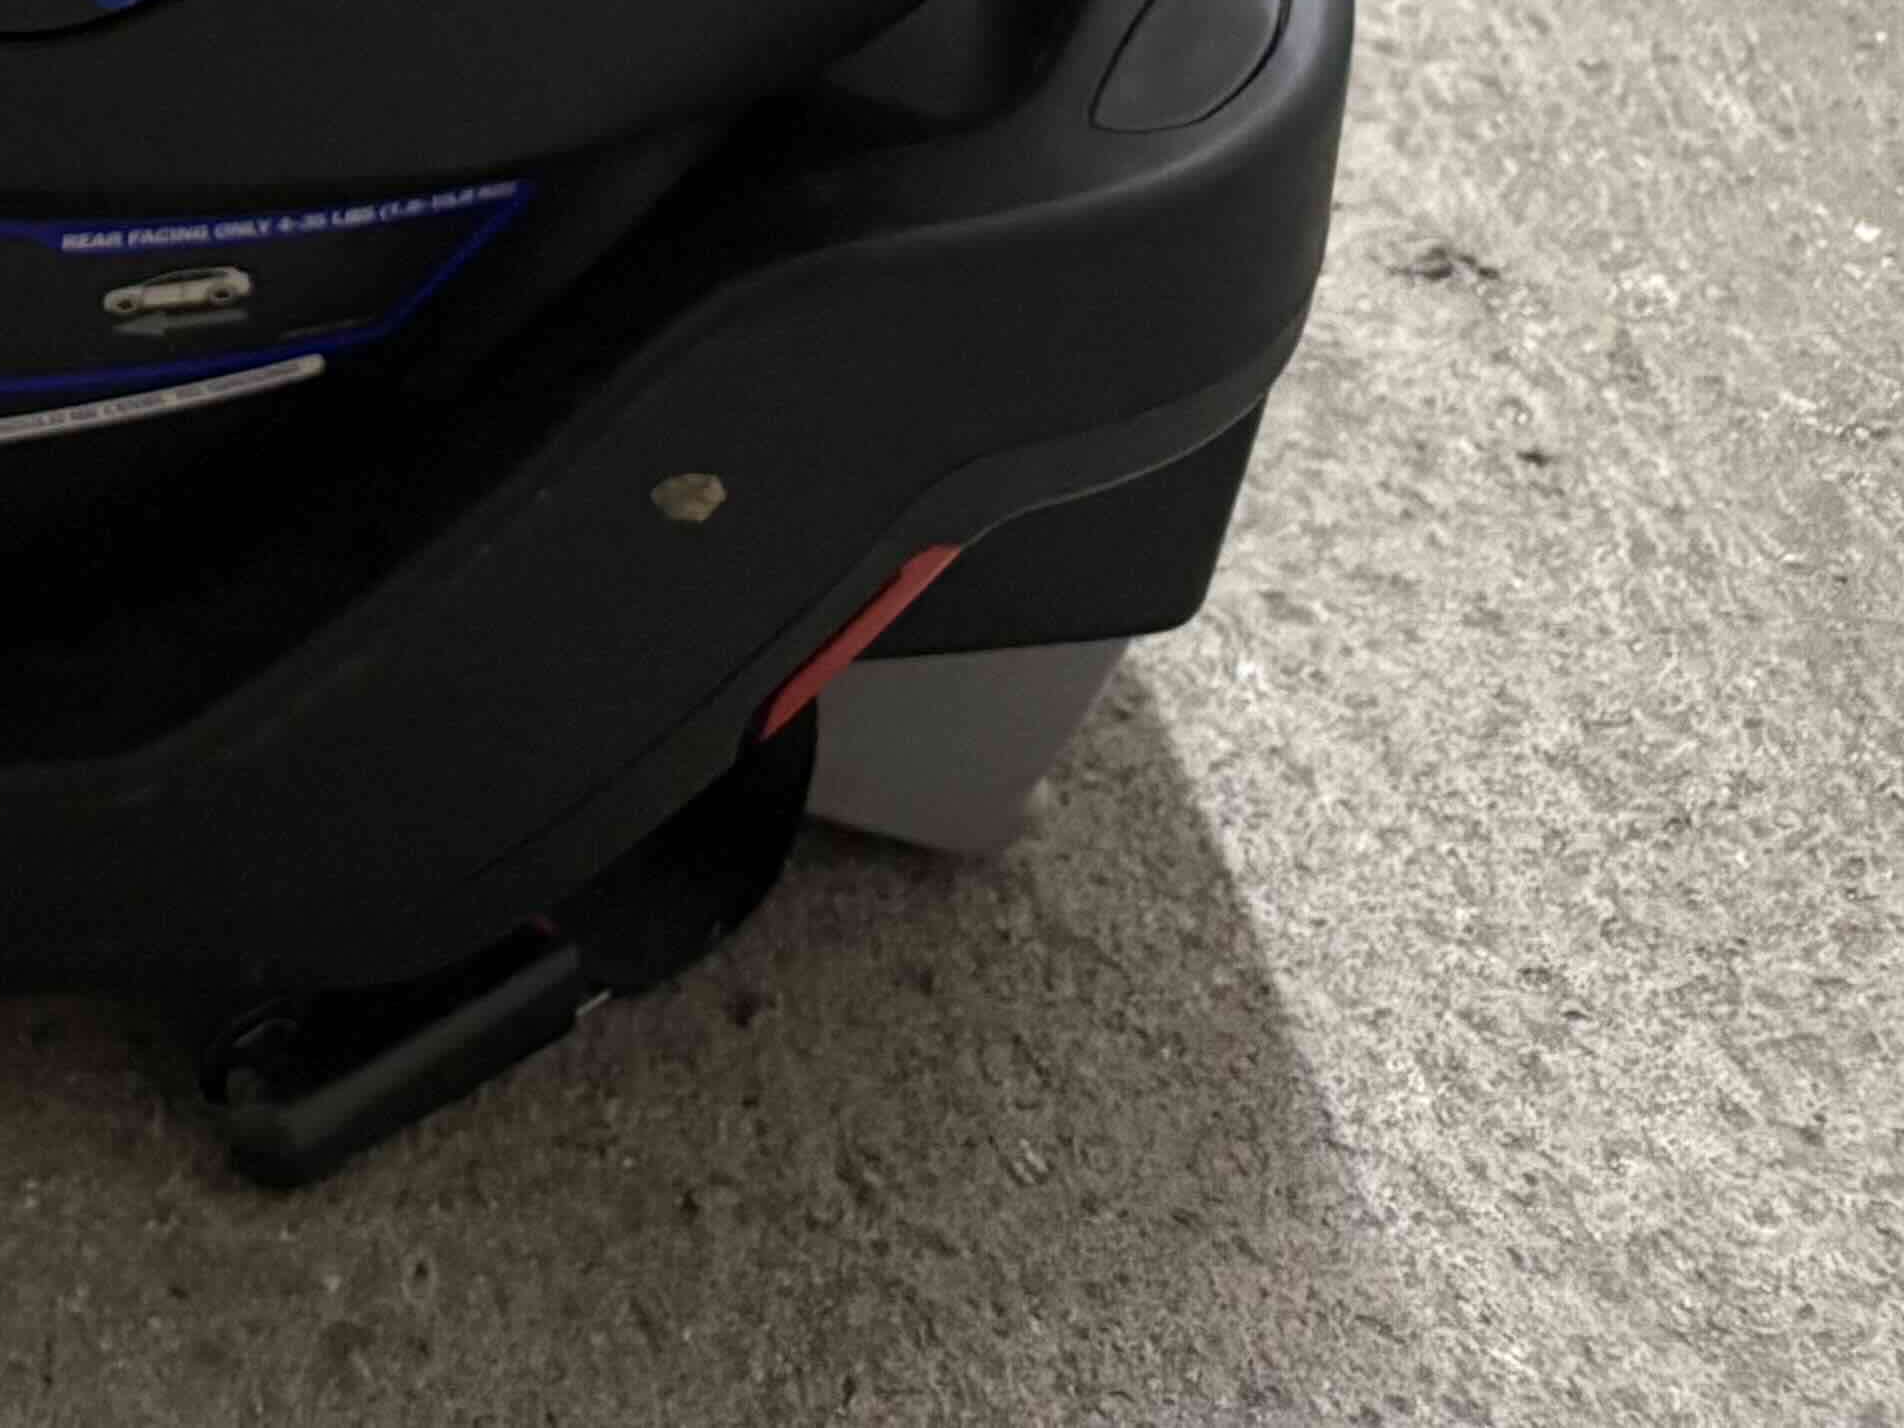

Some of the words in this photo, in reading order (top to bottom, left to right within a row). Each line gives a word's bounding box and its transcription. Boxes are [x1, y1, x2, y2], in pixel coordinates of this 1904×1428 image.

[60, 231, 123, 252] REAR
[127, 224, 209, 248] FACING
[213, 217, 272, 241] ONLY
